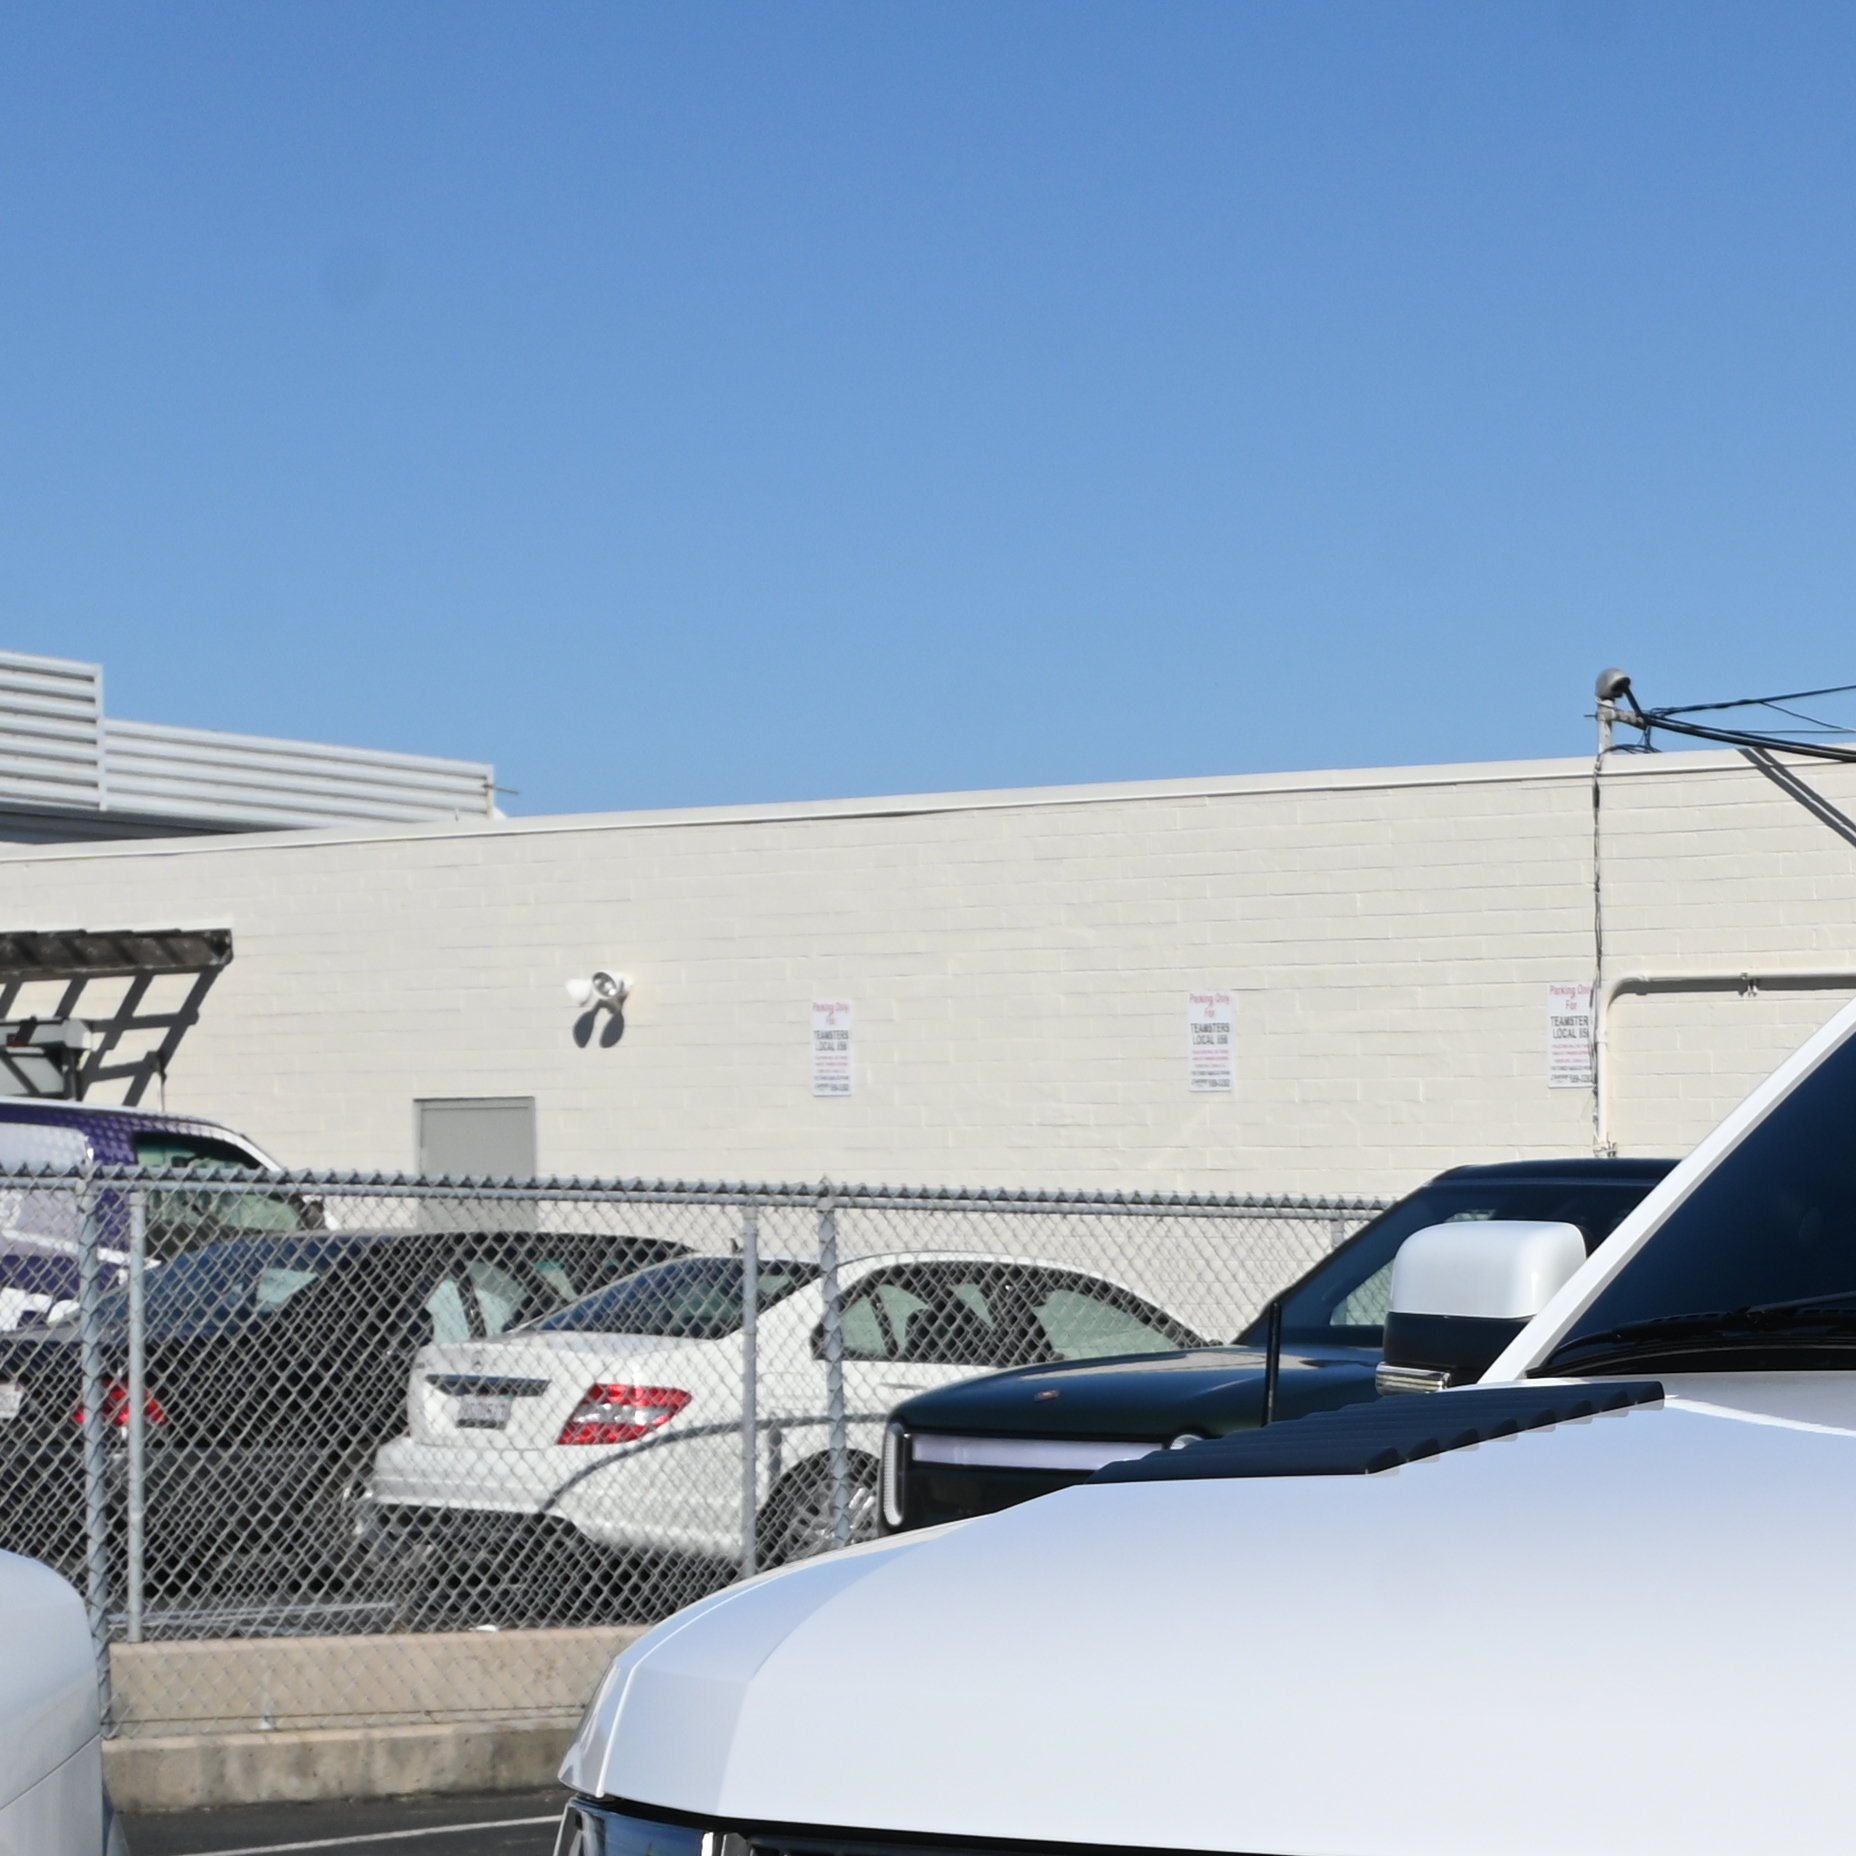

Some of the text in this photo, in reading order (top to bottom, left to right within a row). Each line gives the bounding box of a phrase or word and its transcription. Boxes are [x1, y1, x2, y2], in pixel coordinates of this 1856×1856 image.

[1550, 1016, 1588, 1026] TEAMSTER
[1190, 1023, 1230, 1033] TEAMSTERS
[1553, 1028, 1576, 1039] LOCAL
[1193, 1034, 1215, 1045] LOCAL
[815, 1041, 835, 1051] LOCAL
